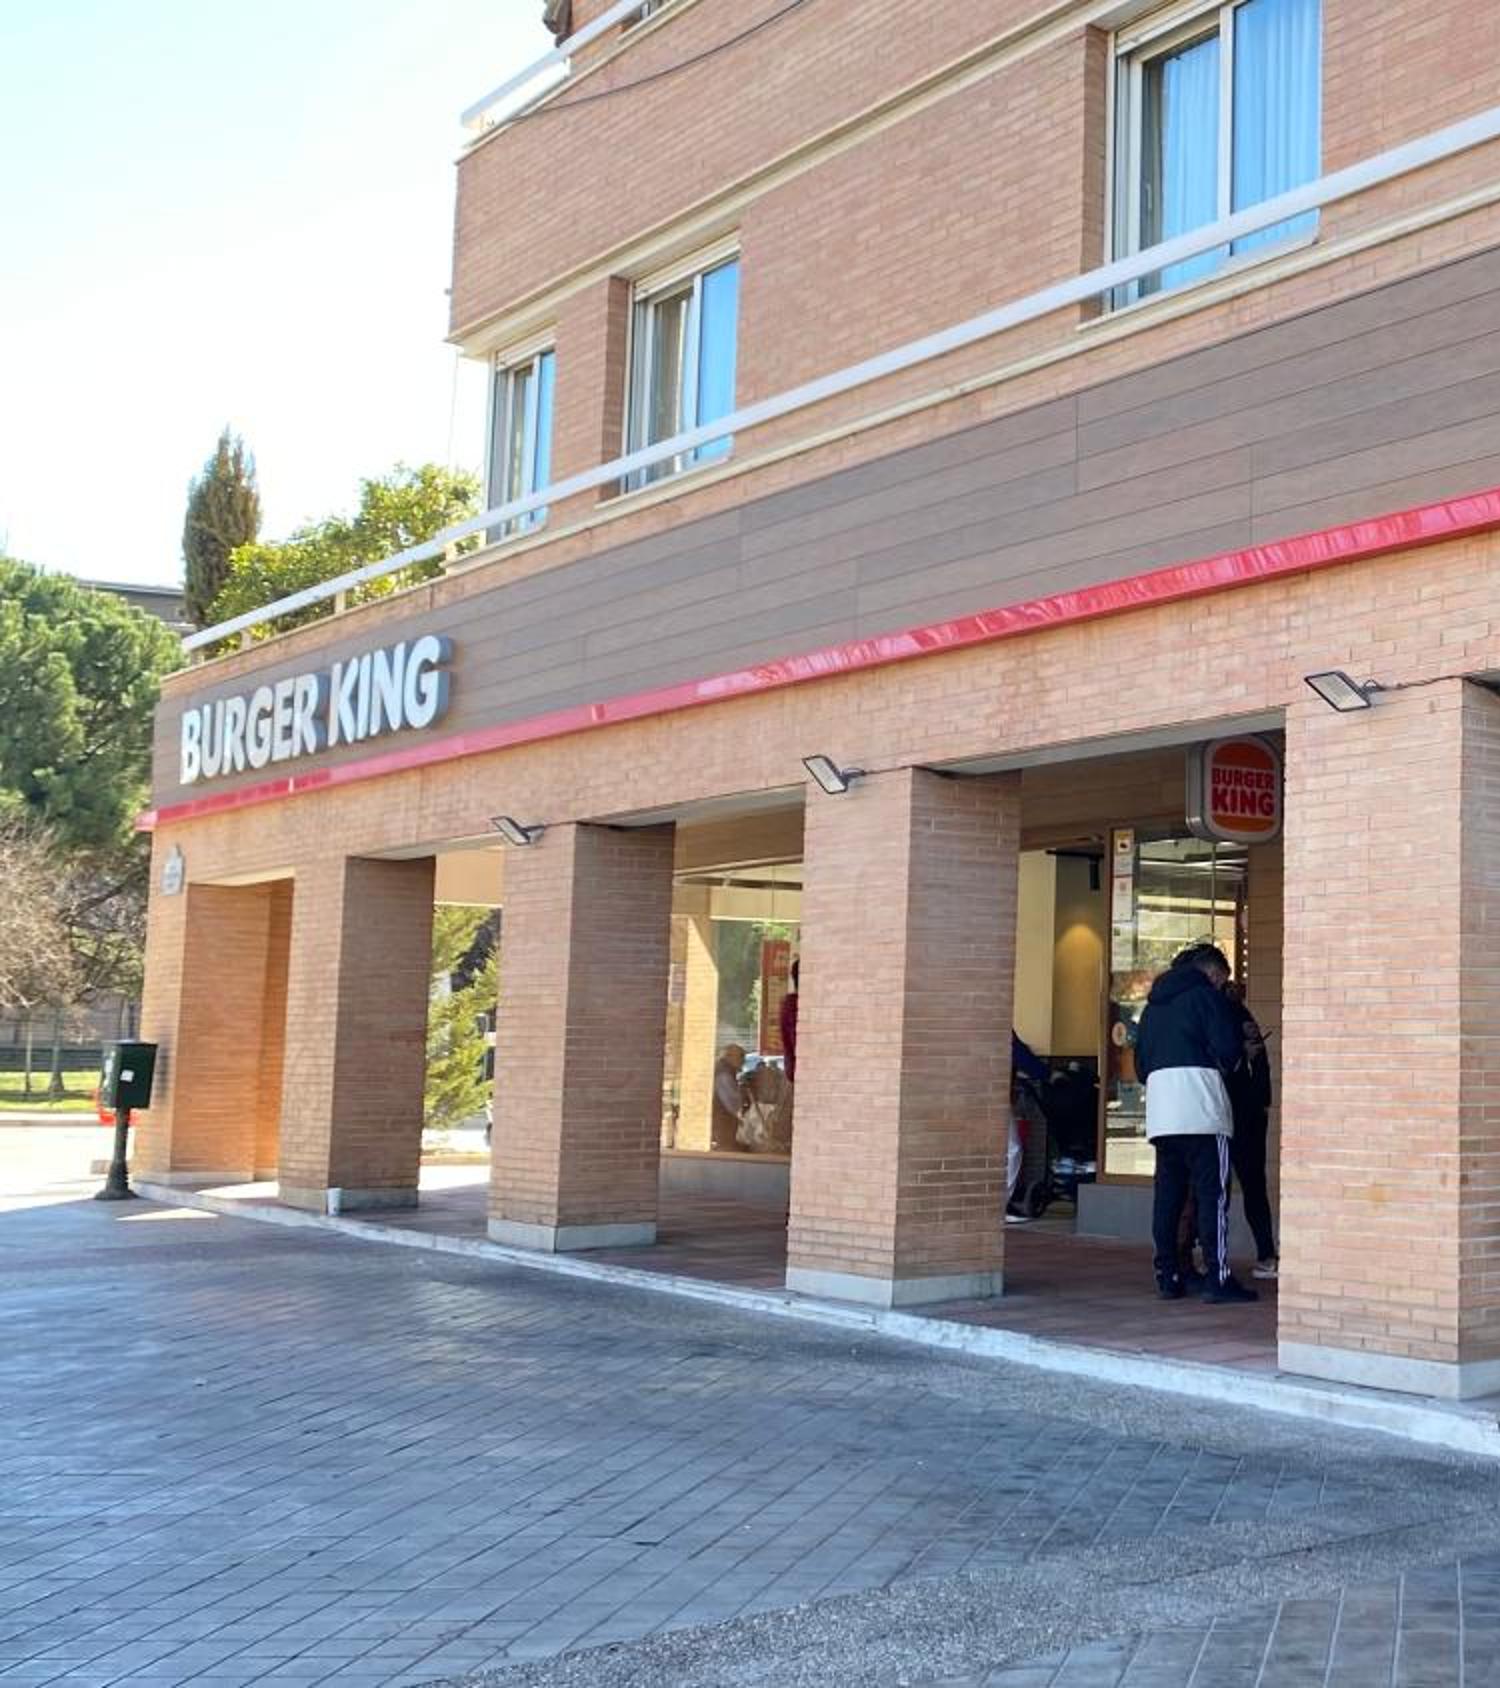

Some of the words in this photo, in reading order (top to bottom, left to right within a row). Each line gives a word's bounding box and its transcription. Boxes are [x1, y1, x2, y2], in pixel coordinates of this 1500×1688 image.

[179, 673, 319, 785] BURGER
[328, 635, 441, 747] KING
[1212, 768, 1275, 790] BURGER
[1212, 787, 1275, 817] KING
